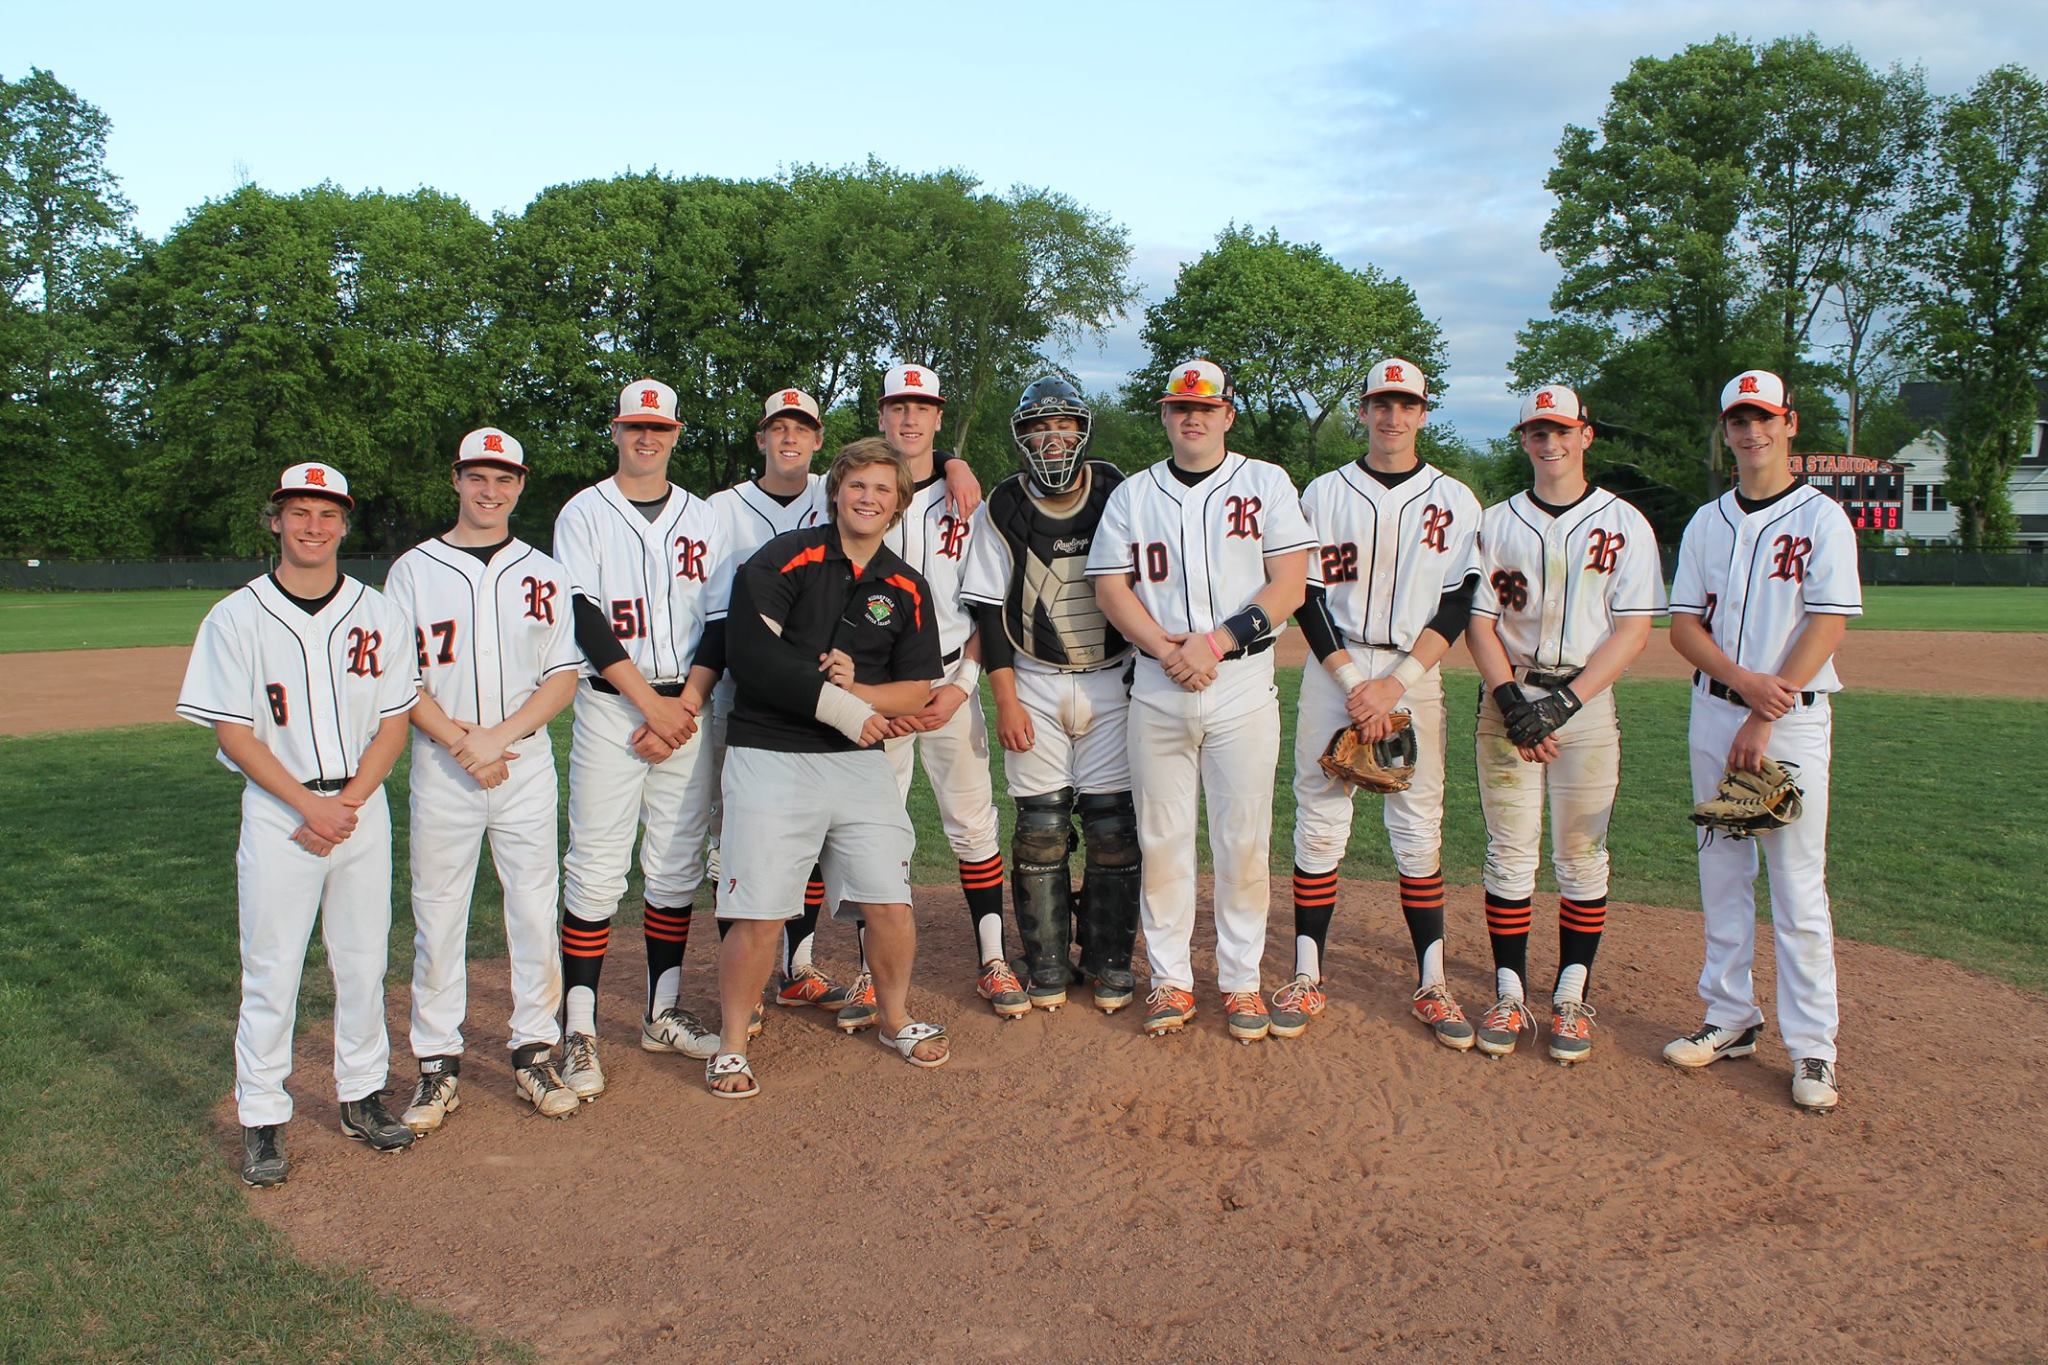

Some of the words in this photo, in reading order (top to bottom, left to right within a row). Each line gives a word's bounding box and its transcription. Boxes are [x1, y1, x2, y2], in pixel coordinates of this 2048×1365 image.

[904, 370, 923, 387] R
[1384, 365, 1404, 382] R
[1738, 376, 1760, 394] R
[641, 390, 660, 409] R
[783, 391, 801, 406] R
[1535, 391, 1556, 410] R
[483, 434, 504, 453] R
[1807, 455, 1878, 473] STADIUM
[305, 467, 327, 487] R
[1808, 476, 1833, 486] STRIKE
[1841, 476, 1856, 486] OUT
[1225, 496, 1262, 541] R
[1889, 507, 1896, 517] 0
[1420, 503, 1454, 554] R
[1889, 517, 1896, 528] 0
[936, 514, 970, 562] R
[1053, 538, 1088, 553] Rawlings
[675, 536, 707, 583] R
[1584, 527, 1625, 575] R
[1768, 534, 1812, 584] R
[1131, 542, 1168, 583] 10
[1320, 541, 1358, 585] 22
[522, 576, 557, 626] R
[611, 597, 647, 640] 51
[347, 626, 383, 679] R
[266, 682, 289, 727] 8
